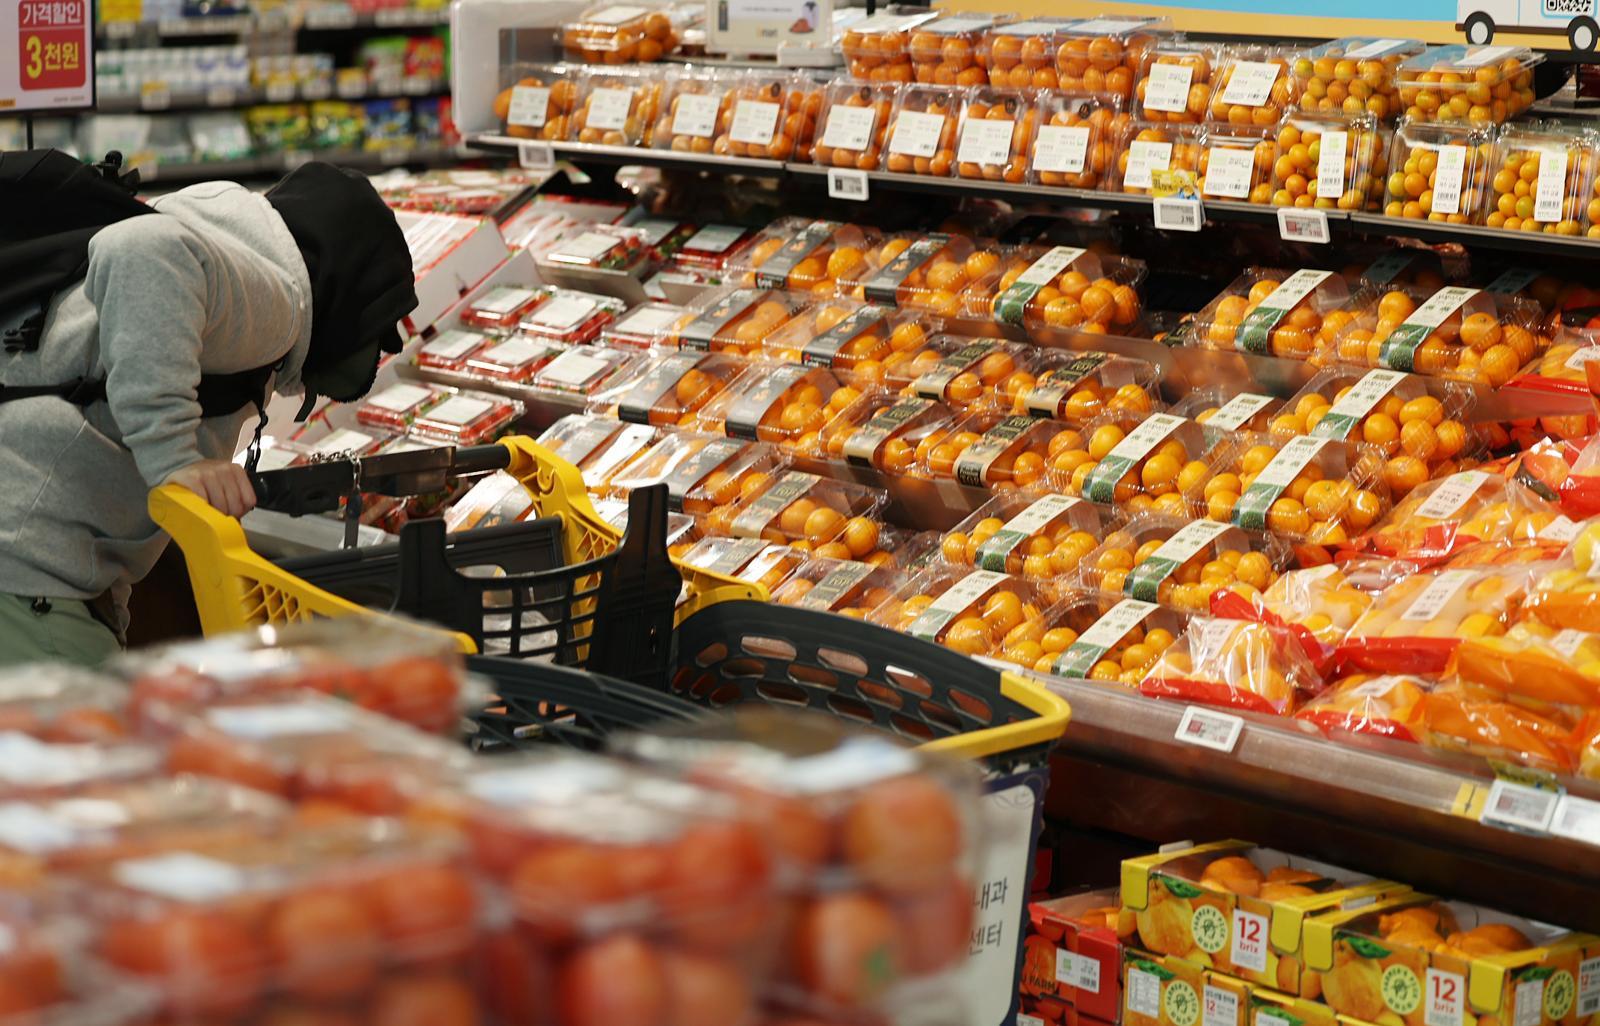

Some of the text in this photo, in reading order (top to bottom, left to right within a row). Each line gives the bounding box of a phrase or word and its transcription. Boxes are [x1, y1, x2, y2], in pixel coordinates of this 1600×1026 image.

[23, 2, 80, 25] 가격할인
[26, 35, 79, 79] 3천원
[1238, 916, 1261, 943] 12
[1239, 940, 1259, 954] brix
[1432, 975, 1456, 1003] 12
[1434, 1000, 1455, 1014] brix
